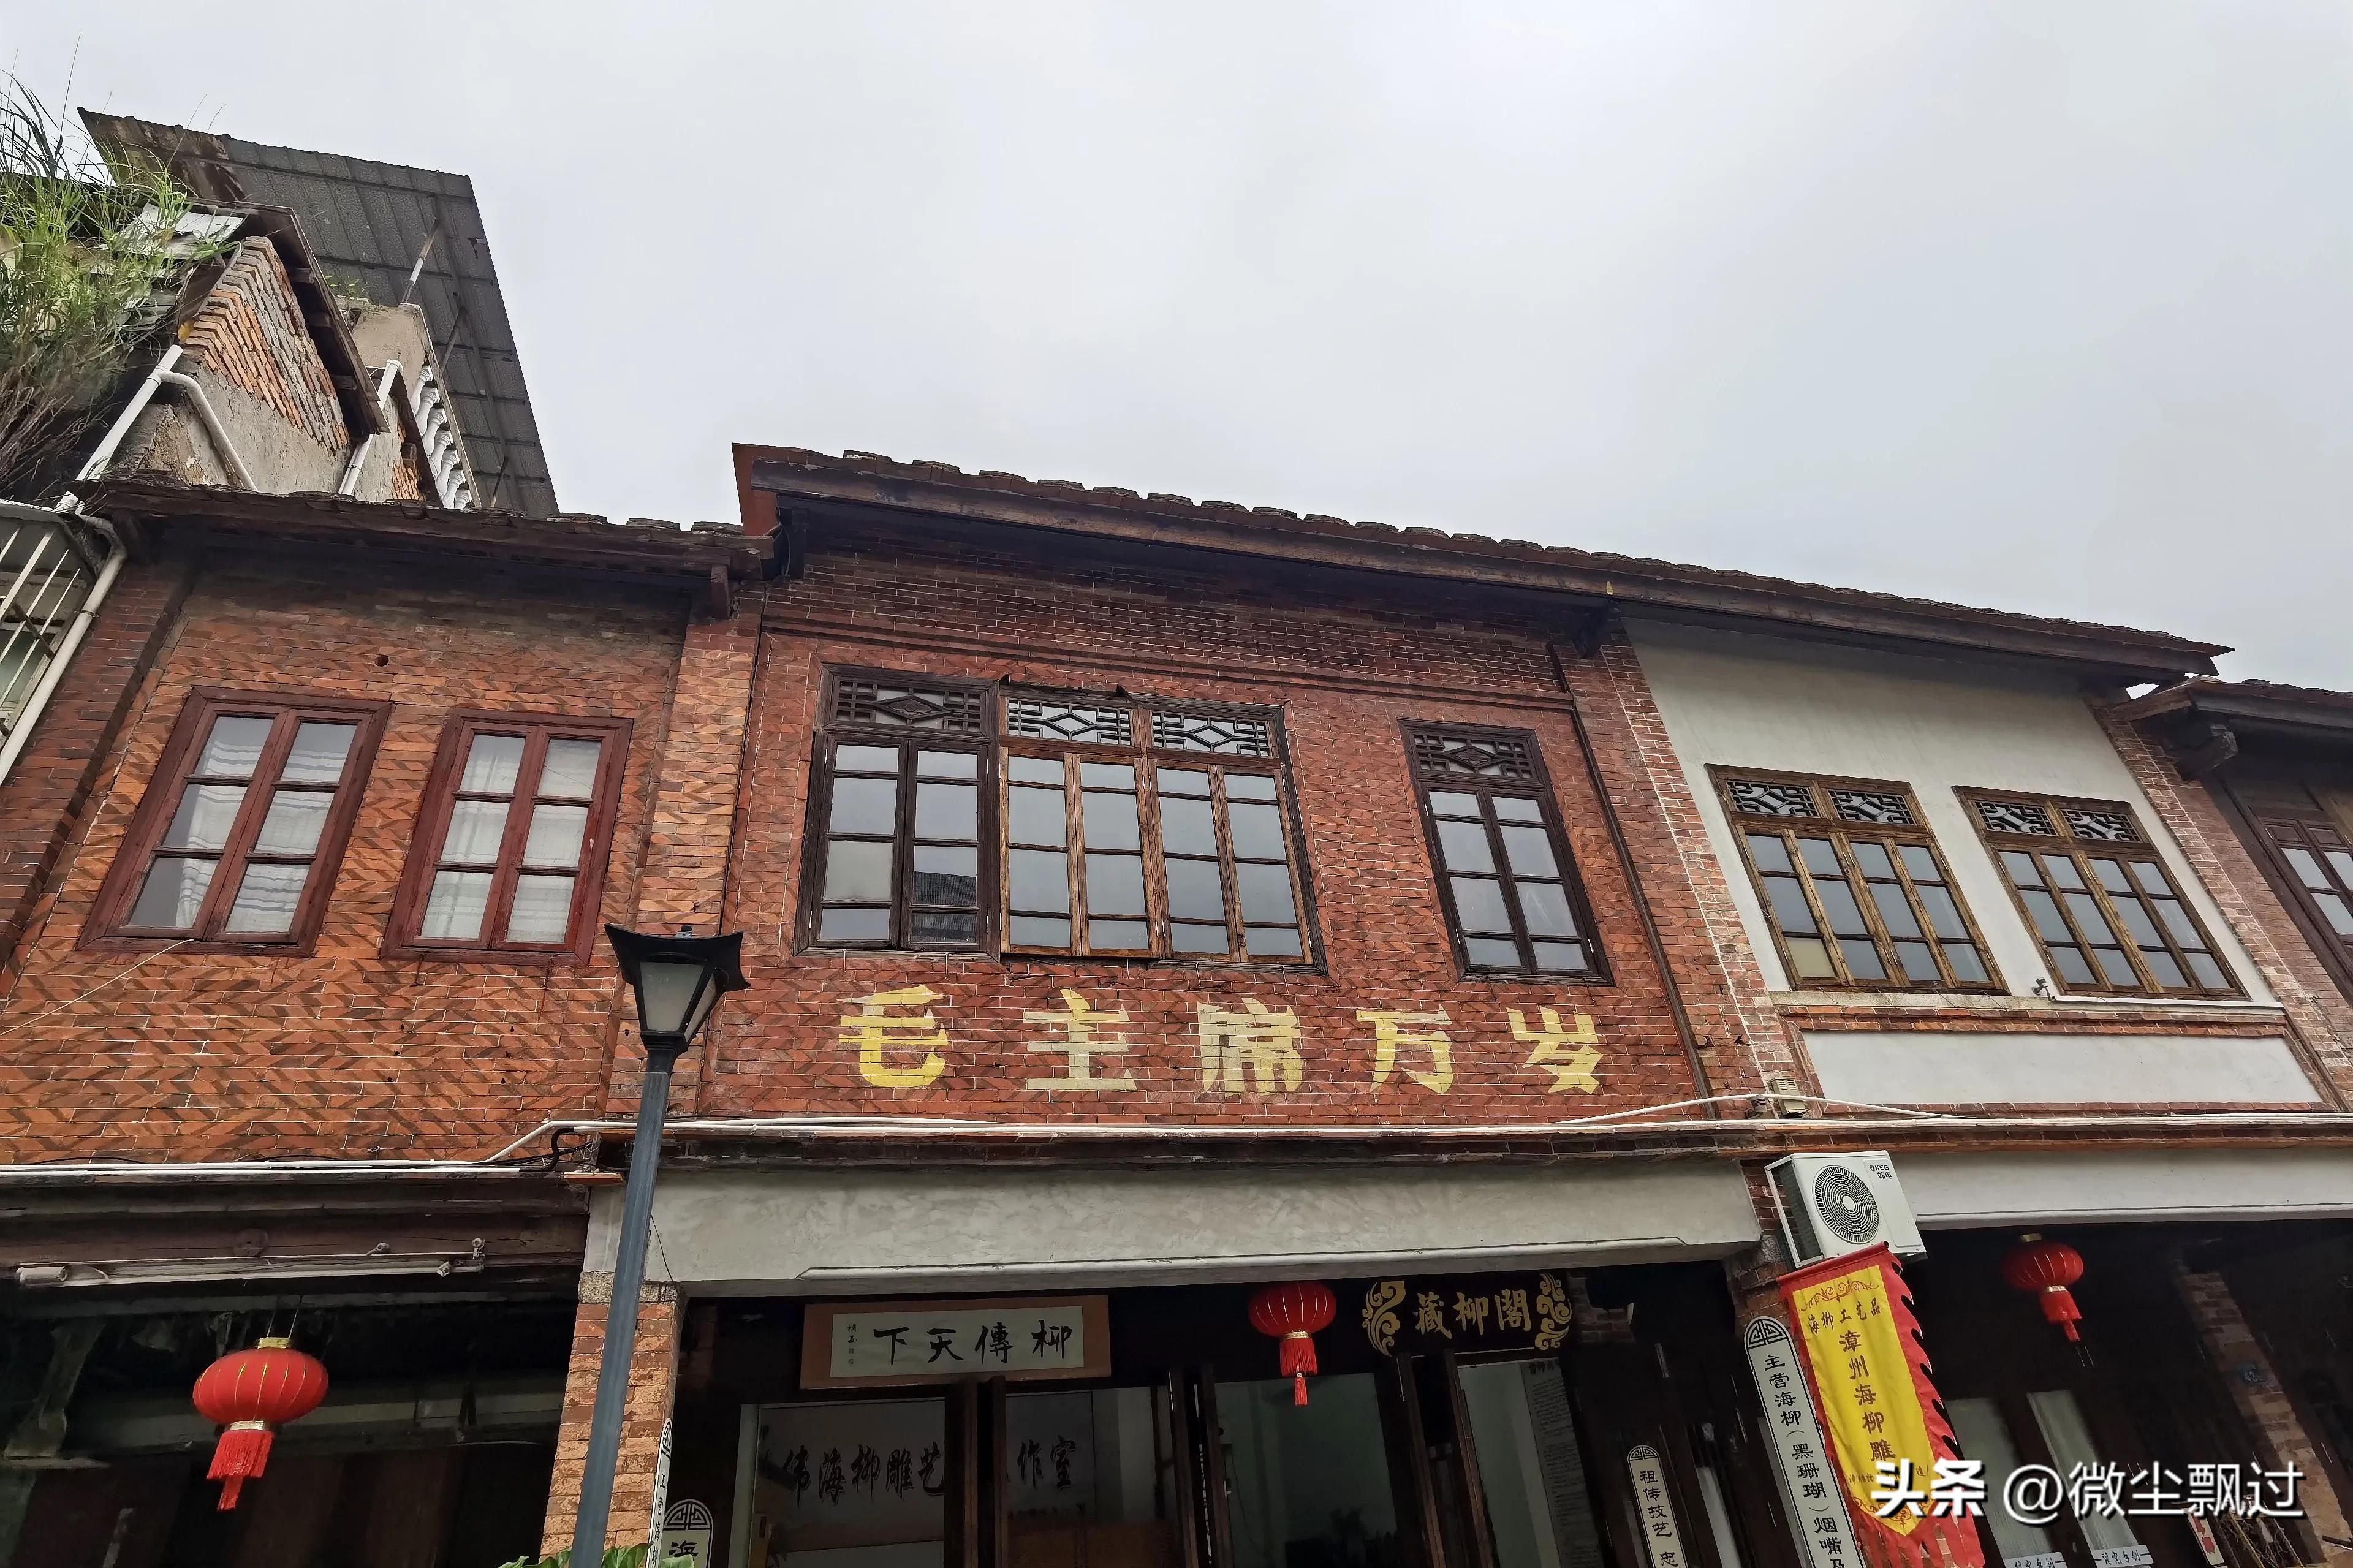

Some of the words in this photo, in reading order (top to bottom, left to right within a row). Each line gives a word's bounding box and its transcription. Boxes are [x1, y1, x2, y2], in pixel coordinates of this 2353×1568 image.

[837, 984, 1605, 1096] 毛主席万岁
[1808, 1297, 1882, 1335] 海柳工艺品
[1838, 1329, 1897, 1463] 漳州海柳雕
[1639, 1469, 1673, 1538] 祖传技艺
